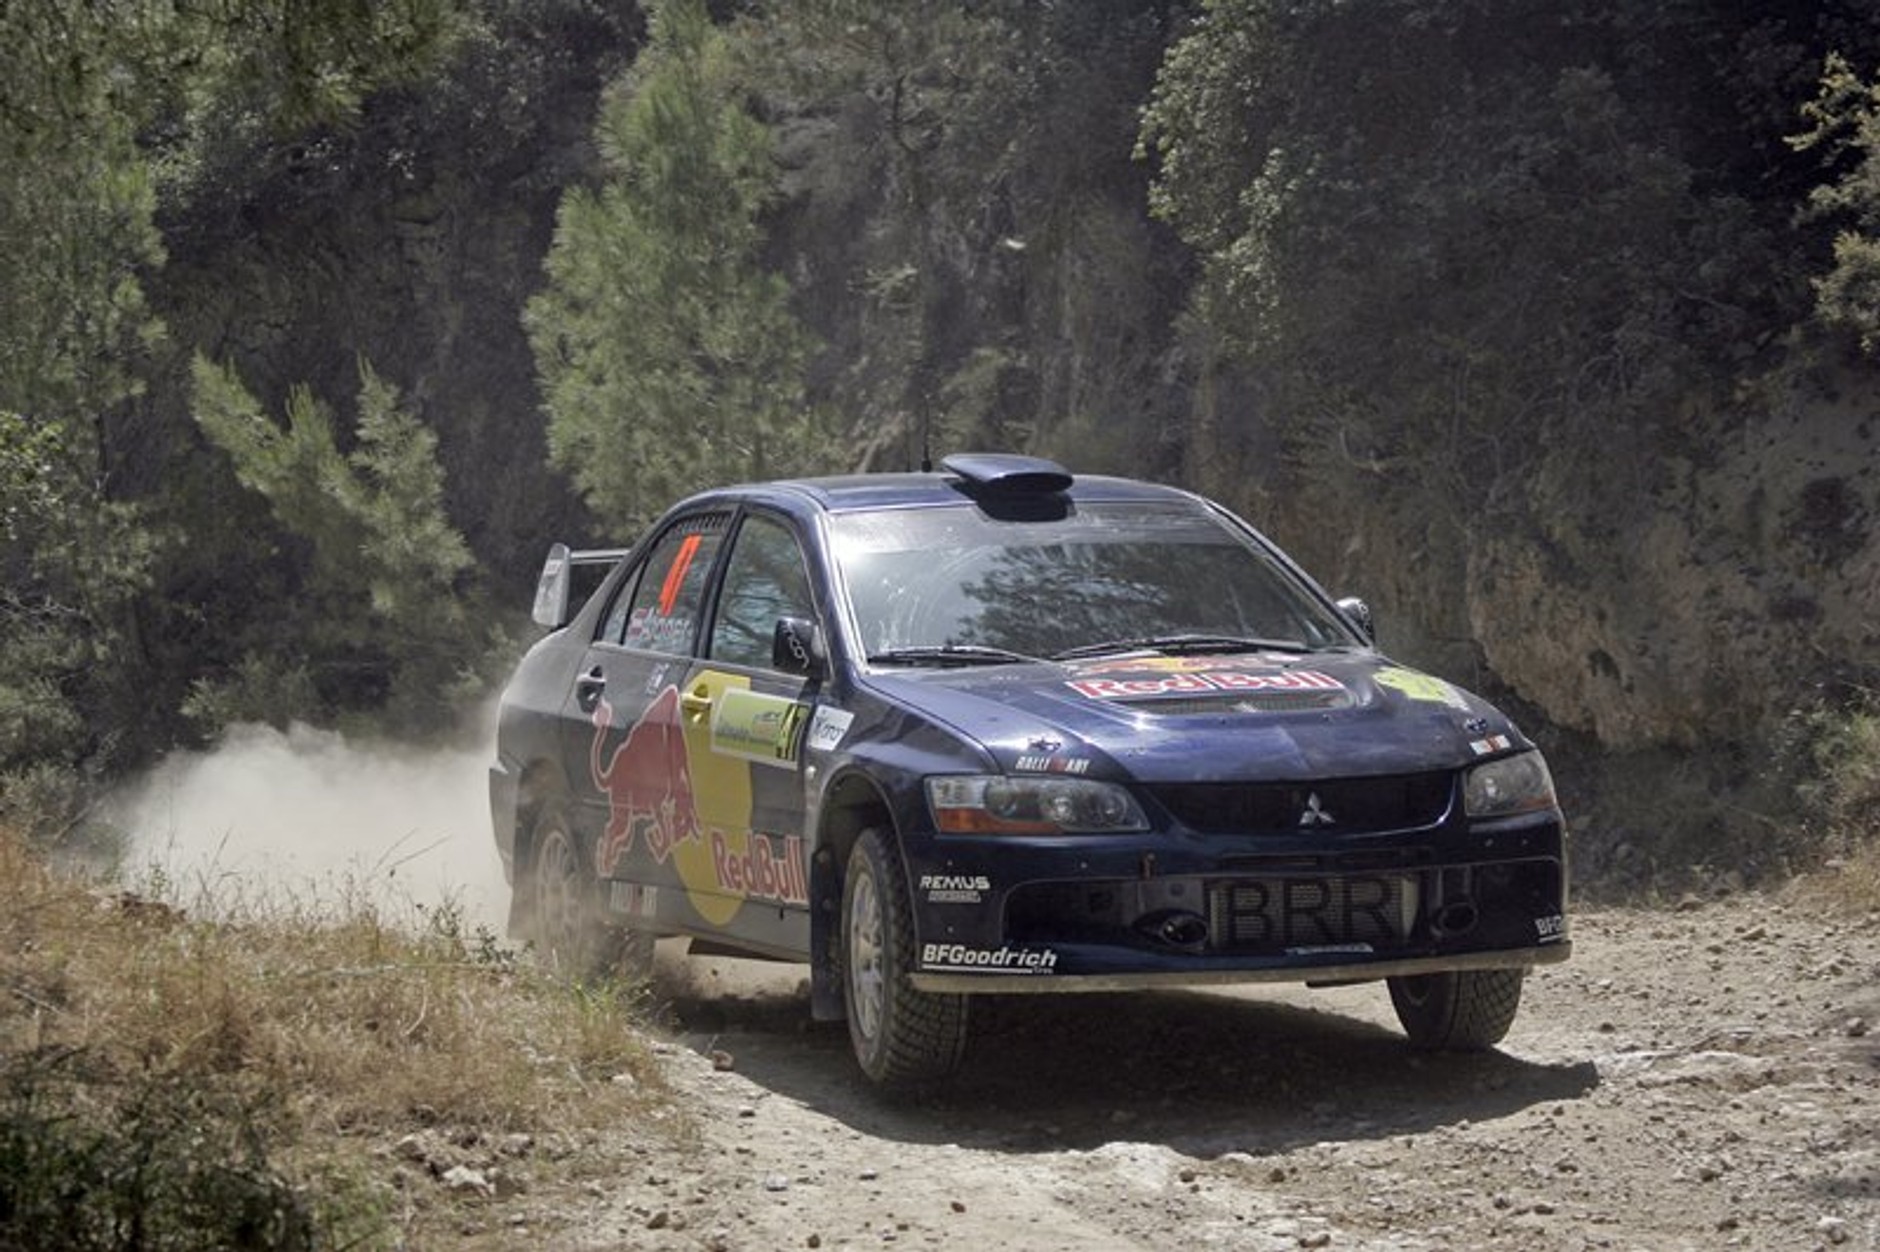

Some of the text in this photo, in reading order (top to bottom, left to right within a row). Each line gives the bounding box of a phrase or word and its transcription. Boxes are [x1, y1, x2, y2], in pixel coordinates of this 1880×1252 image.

[1065, 671, 1345, 698] Red Bull
[710, 827, 809, 904] Red Bull
[920, 876, 990, 889] REMUS
[1228, 879, 1397, 943] BRR
[922, 944, 1057, 967] BFGoodrich
